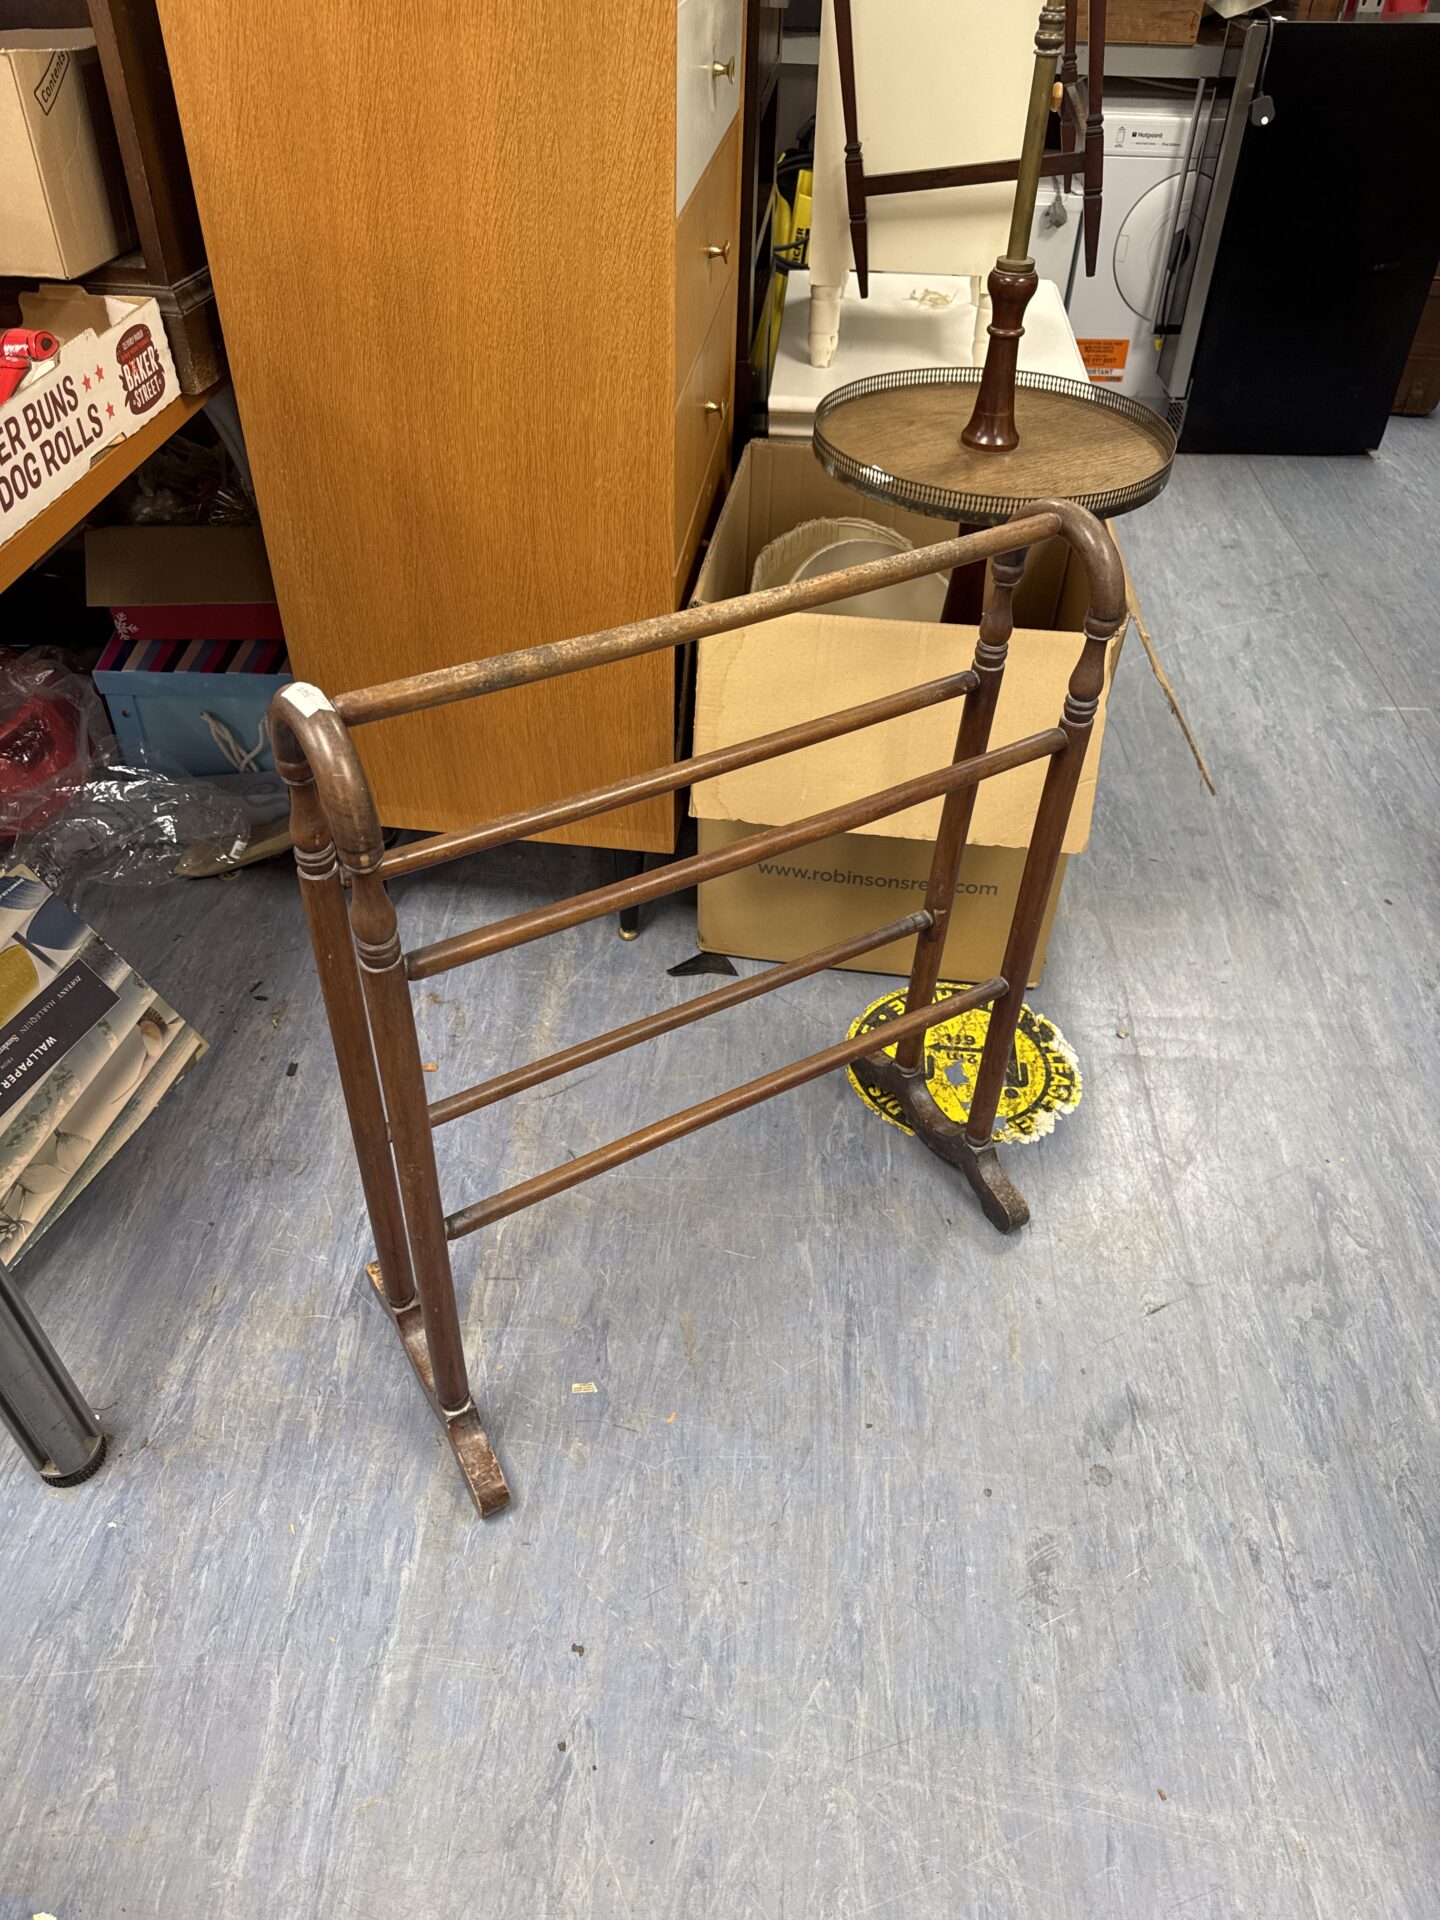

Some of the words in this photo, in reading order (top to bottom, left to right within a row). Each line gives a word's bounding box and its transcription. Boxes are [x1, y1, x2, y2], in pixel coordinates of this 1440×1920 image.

[41, 50, 66, 103] Contents
[1137, 131, 1163, 139] Hotpoint
[122, 346, 159, 392] BAKER
[134, 374, 160, 408] STREET
[22, 375, 79, 442] BUNS
[0, 452, 42, 513] DOG
[39, 403, 104, 477] ROLLS
[20, 999, 56, 1034] HARLEQUIN
[1, 1036, 58, 1090] WALLPAPER
